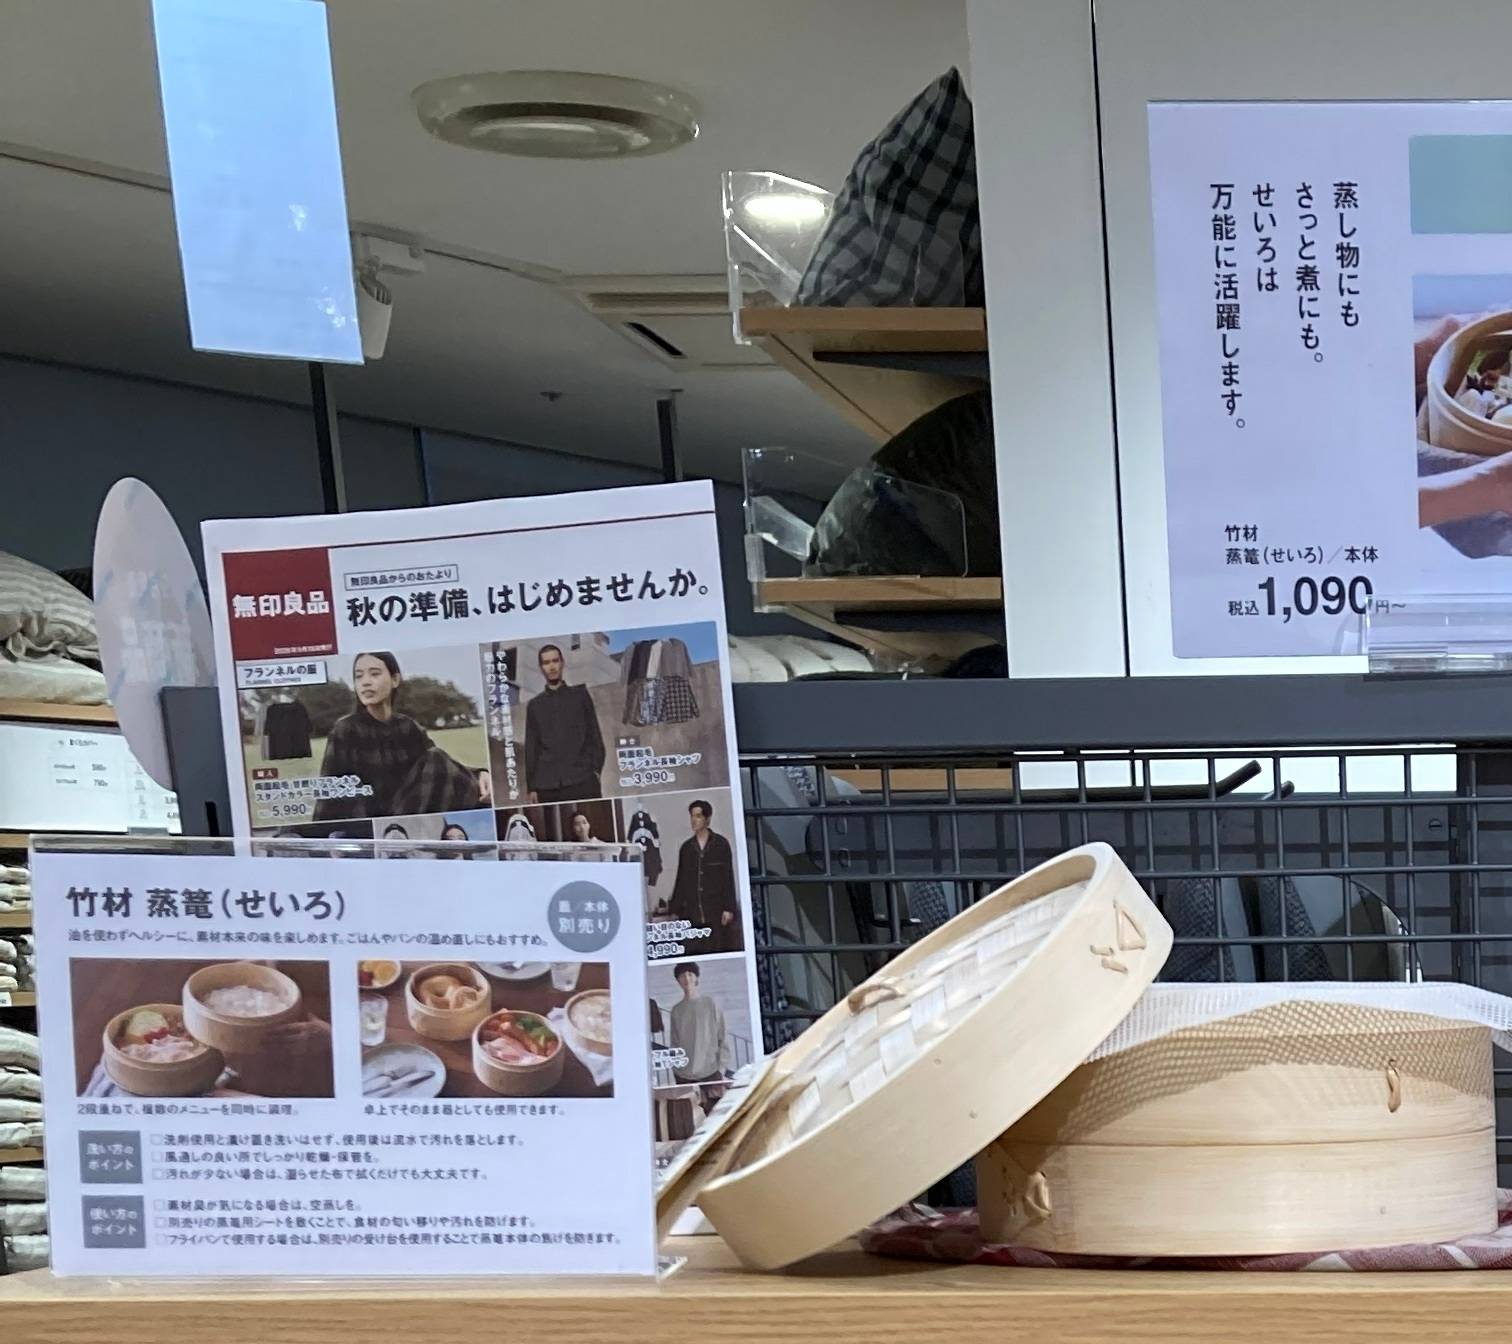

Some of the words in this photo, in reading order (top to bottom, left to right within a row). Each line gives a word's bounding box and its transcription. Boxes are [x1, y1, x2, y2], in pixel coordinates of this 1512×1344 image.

[1252, 182, 1280, 293] せいろは
[1333, 181, 1360, 327] 蒸し物にも
[1295, 182, 1324, 363] さっと煮にも。
[1209, 183, 1246, 429] 万能に活躍します。
[1224, 524, 1258, 542] 竹材
[231, 590, 330, 618] 無印良品
[346, 566, 710, 628] 秋の準備、はじめませんか。
[66, 886, 133, 918] 竹材
[559, 917, 610, 934] 別売り
[88, 1159, 135, 1171] ポイント
